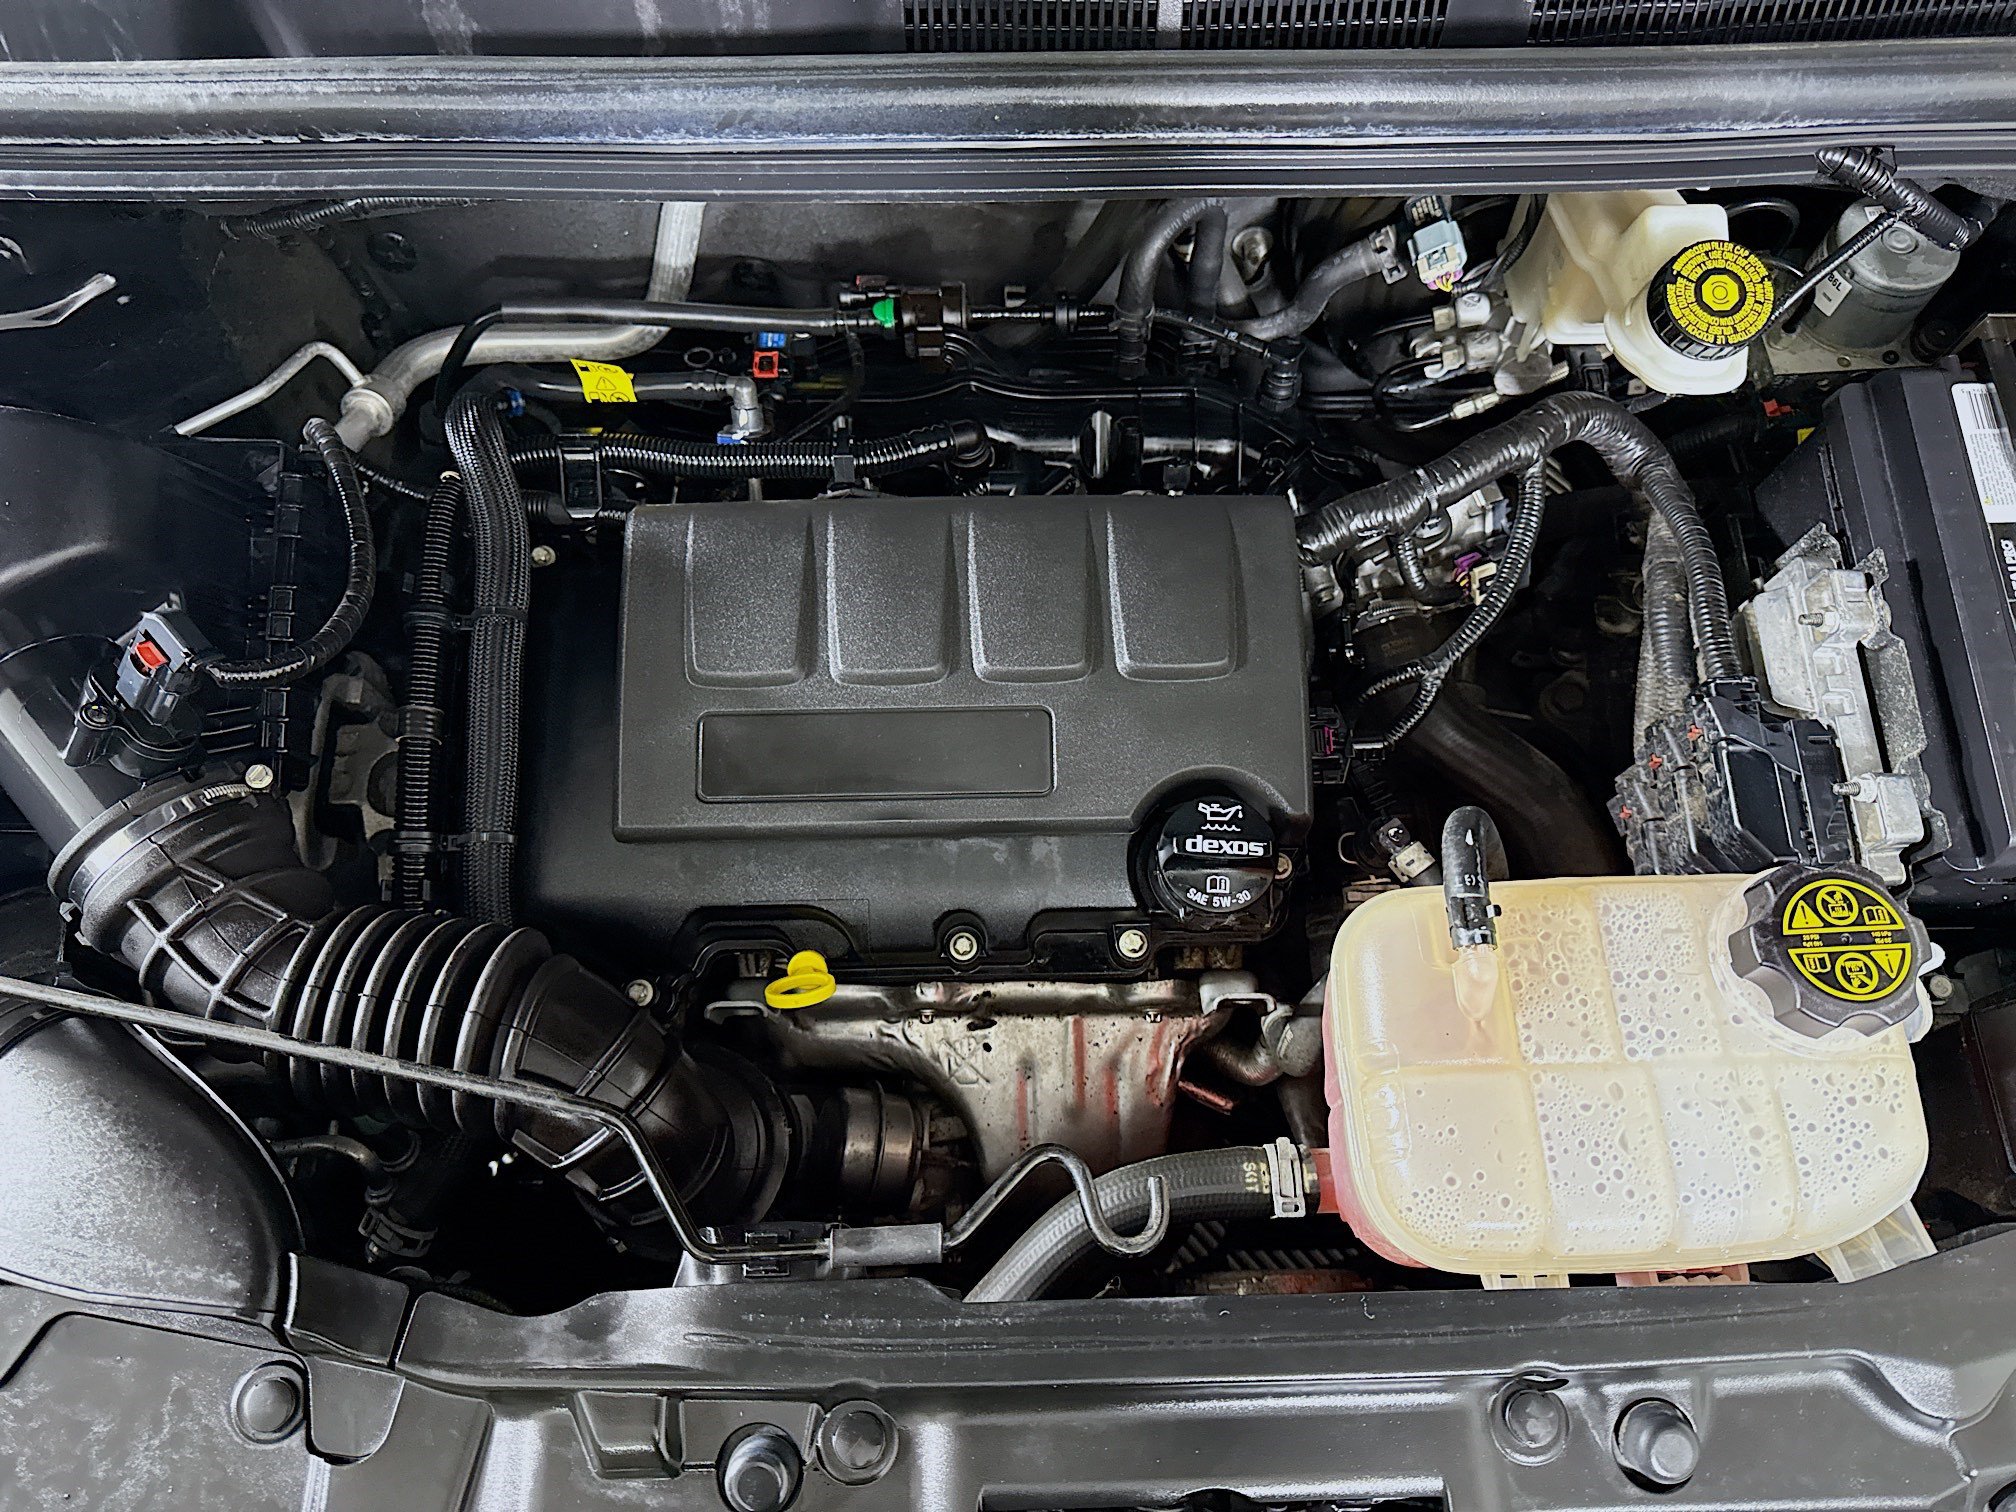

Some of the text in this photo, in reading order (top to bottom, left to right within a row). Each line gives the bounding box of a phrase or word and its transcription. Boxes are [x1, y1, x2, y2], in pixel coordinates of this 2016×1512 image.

[1712, 242, 1733, 252] FILLER
[1734, 246, 1749, 257] CAP
[1186, 835, 1264, 856] dexos
[1186, 888, 1251, 908] SAE 5W-30
